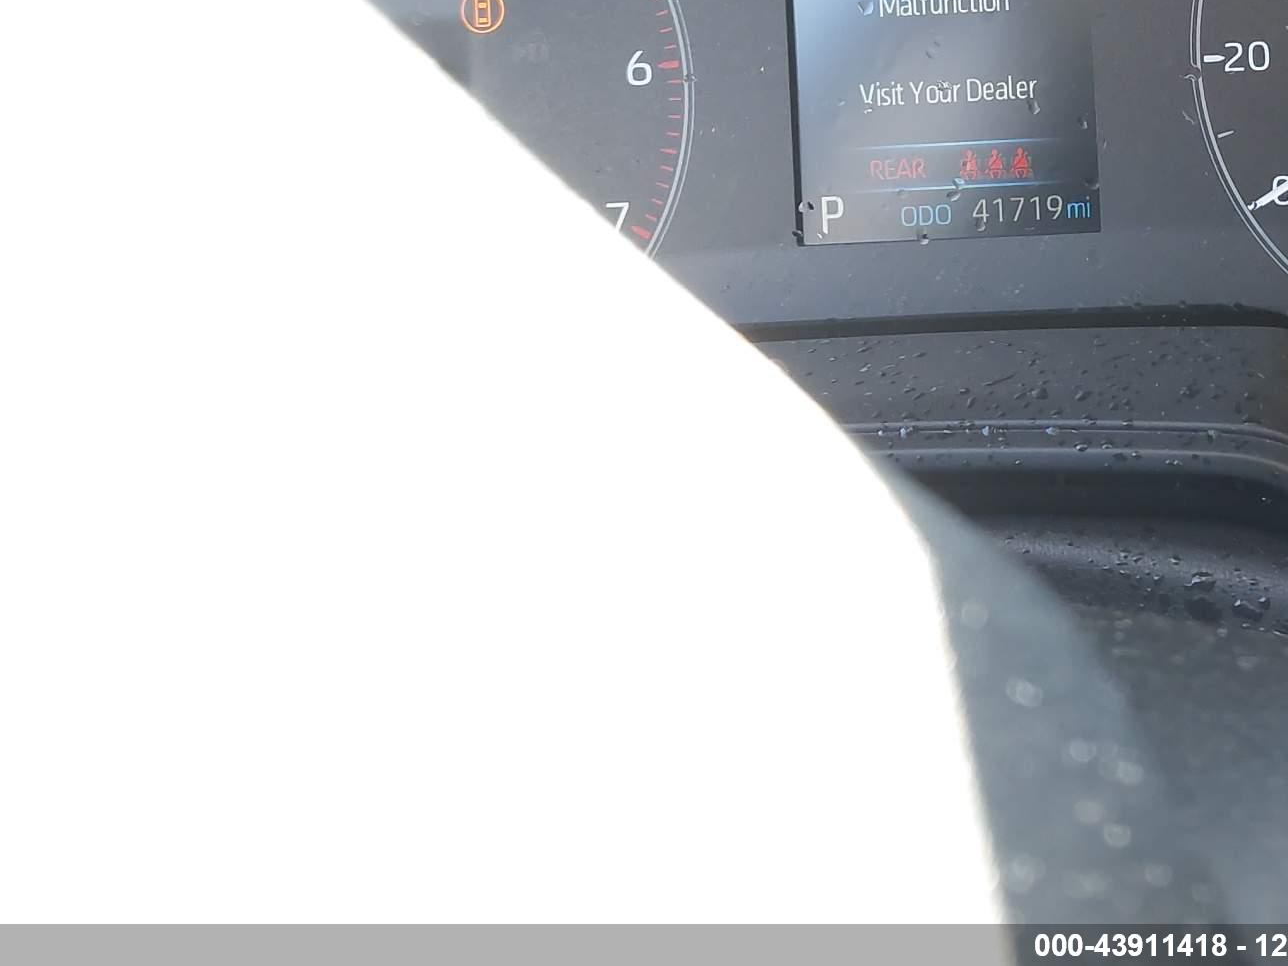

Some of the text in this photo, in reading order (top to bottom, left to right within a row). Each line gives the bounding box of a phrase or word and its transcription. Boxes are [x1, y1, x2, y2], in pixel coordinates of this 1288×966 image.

[626, 50, 652, 86] 6
[1224, 41, 1270, 71] 20
[860, 75, 1037, 107] Visit Your Dealer
[869, 158, 927, 180] REAR
[606, 202, 629, 230] 7
[820, 196, 844, 234] P
[901, 204, 951, 227] ODO
